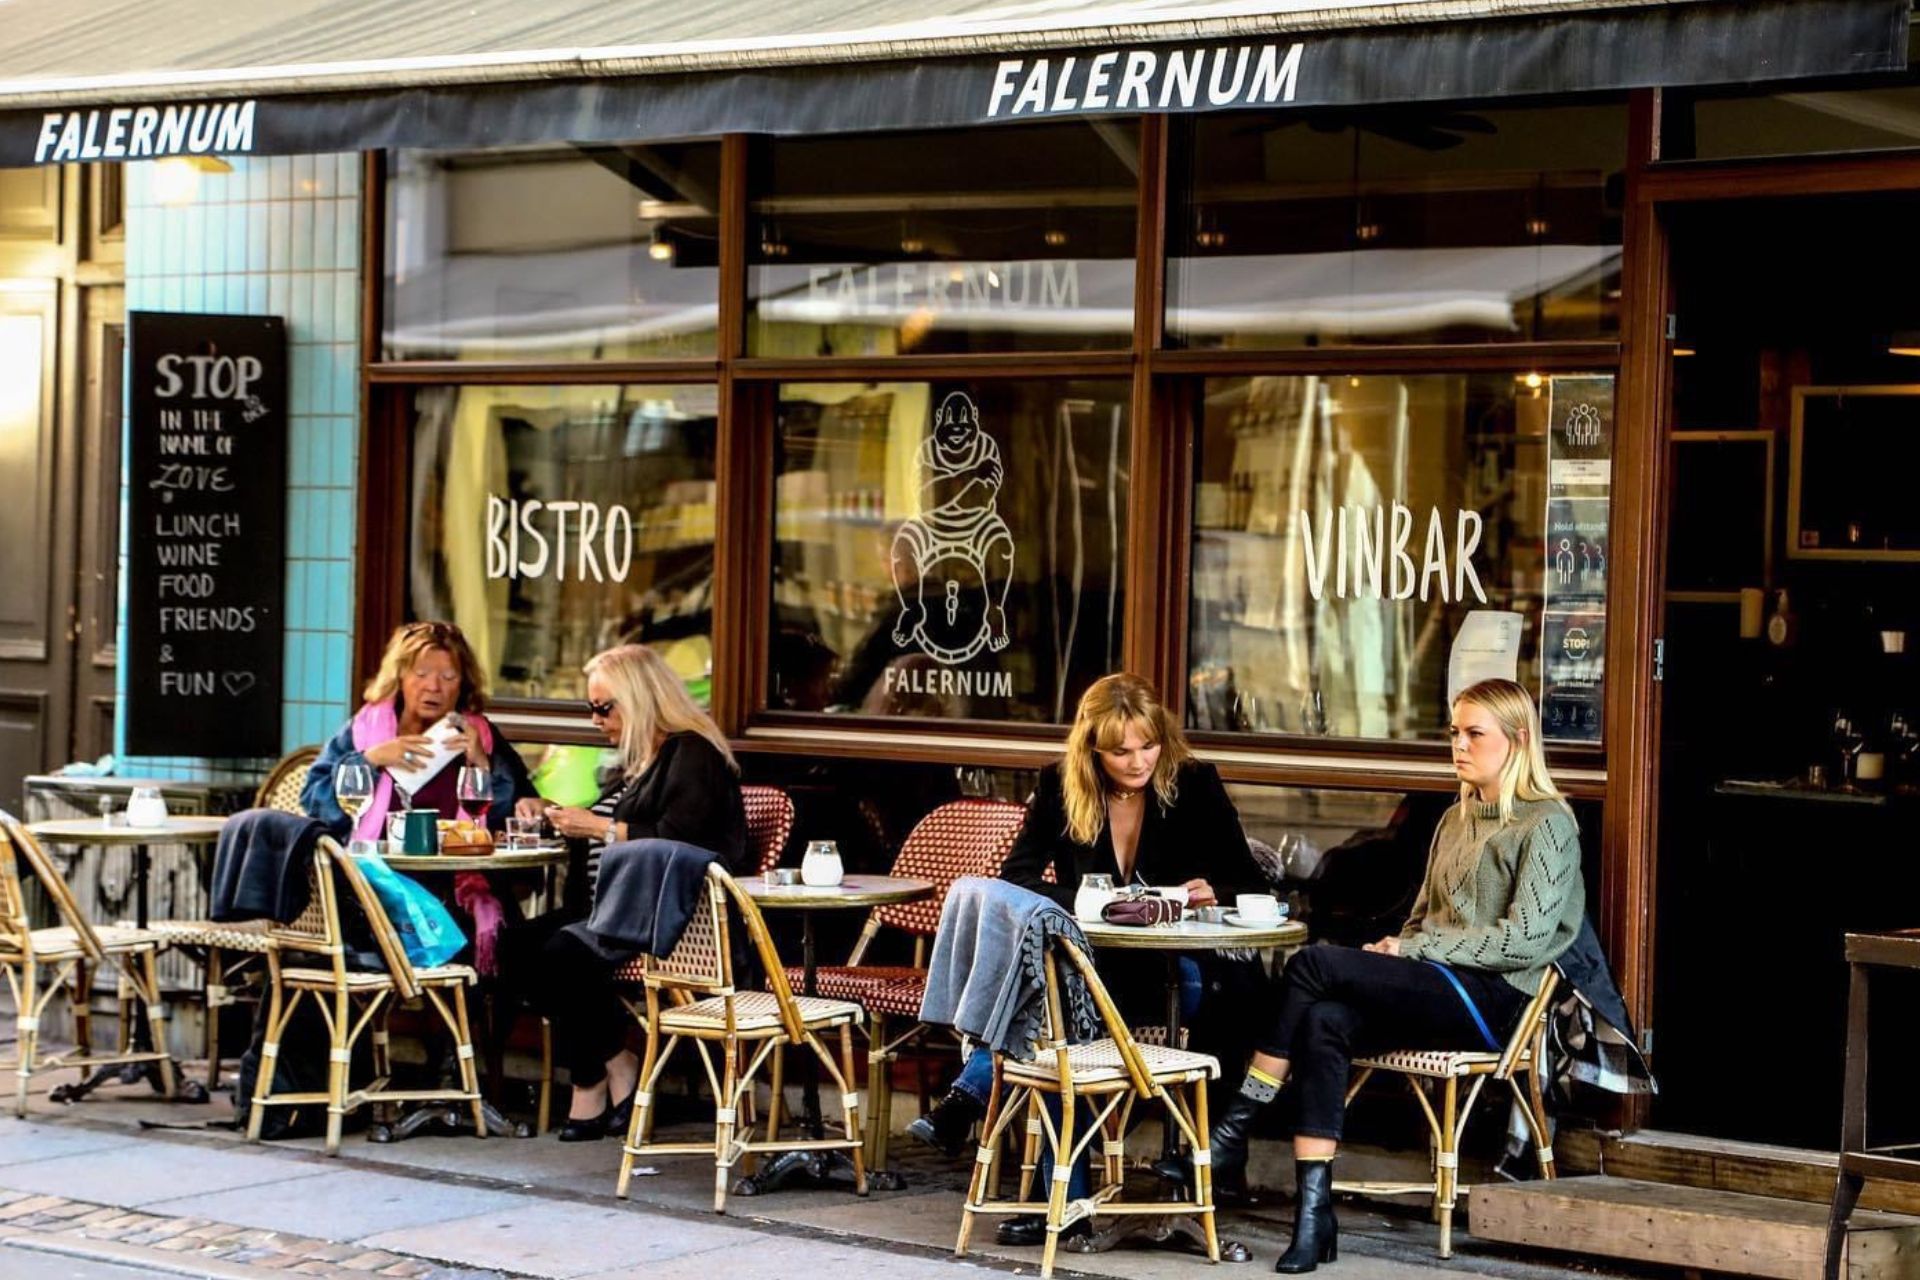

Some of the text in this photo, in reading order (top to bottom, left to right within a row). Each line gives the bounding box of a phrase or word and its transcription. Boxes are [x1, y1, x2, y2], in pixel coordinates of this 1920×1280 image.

[986, 43, 1304, 117] FALERNUM
[34, 100, 256, 163] FALERNUM
[808, 260, 1080, 314] FALERNUM
[154, 353, 263, 400] STOP
[160, 409, 182, 430] IN
[149, 463, 235, 491] LOVE
[155, 513, 241, 538] LUNCH
[486, 493, 633, 583] BISTRO
[157, 542, 222, 567] WINE
[1301, 499, 1487, 604] VINBAR
[158, 572, 215, 598] FOOD
[159, 606, 256, 634] FRIENDS
[158, 643, 175, 663] &
[160, 670, 214, 696] FUN
[884, 667, 1014, 698] FALERNUM
